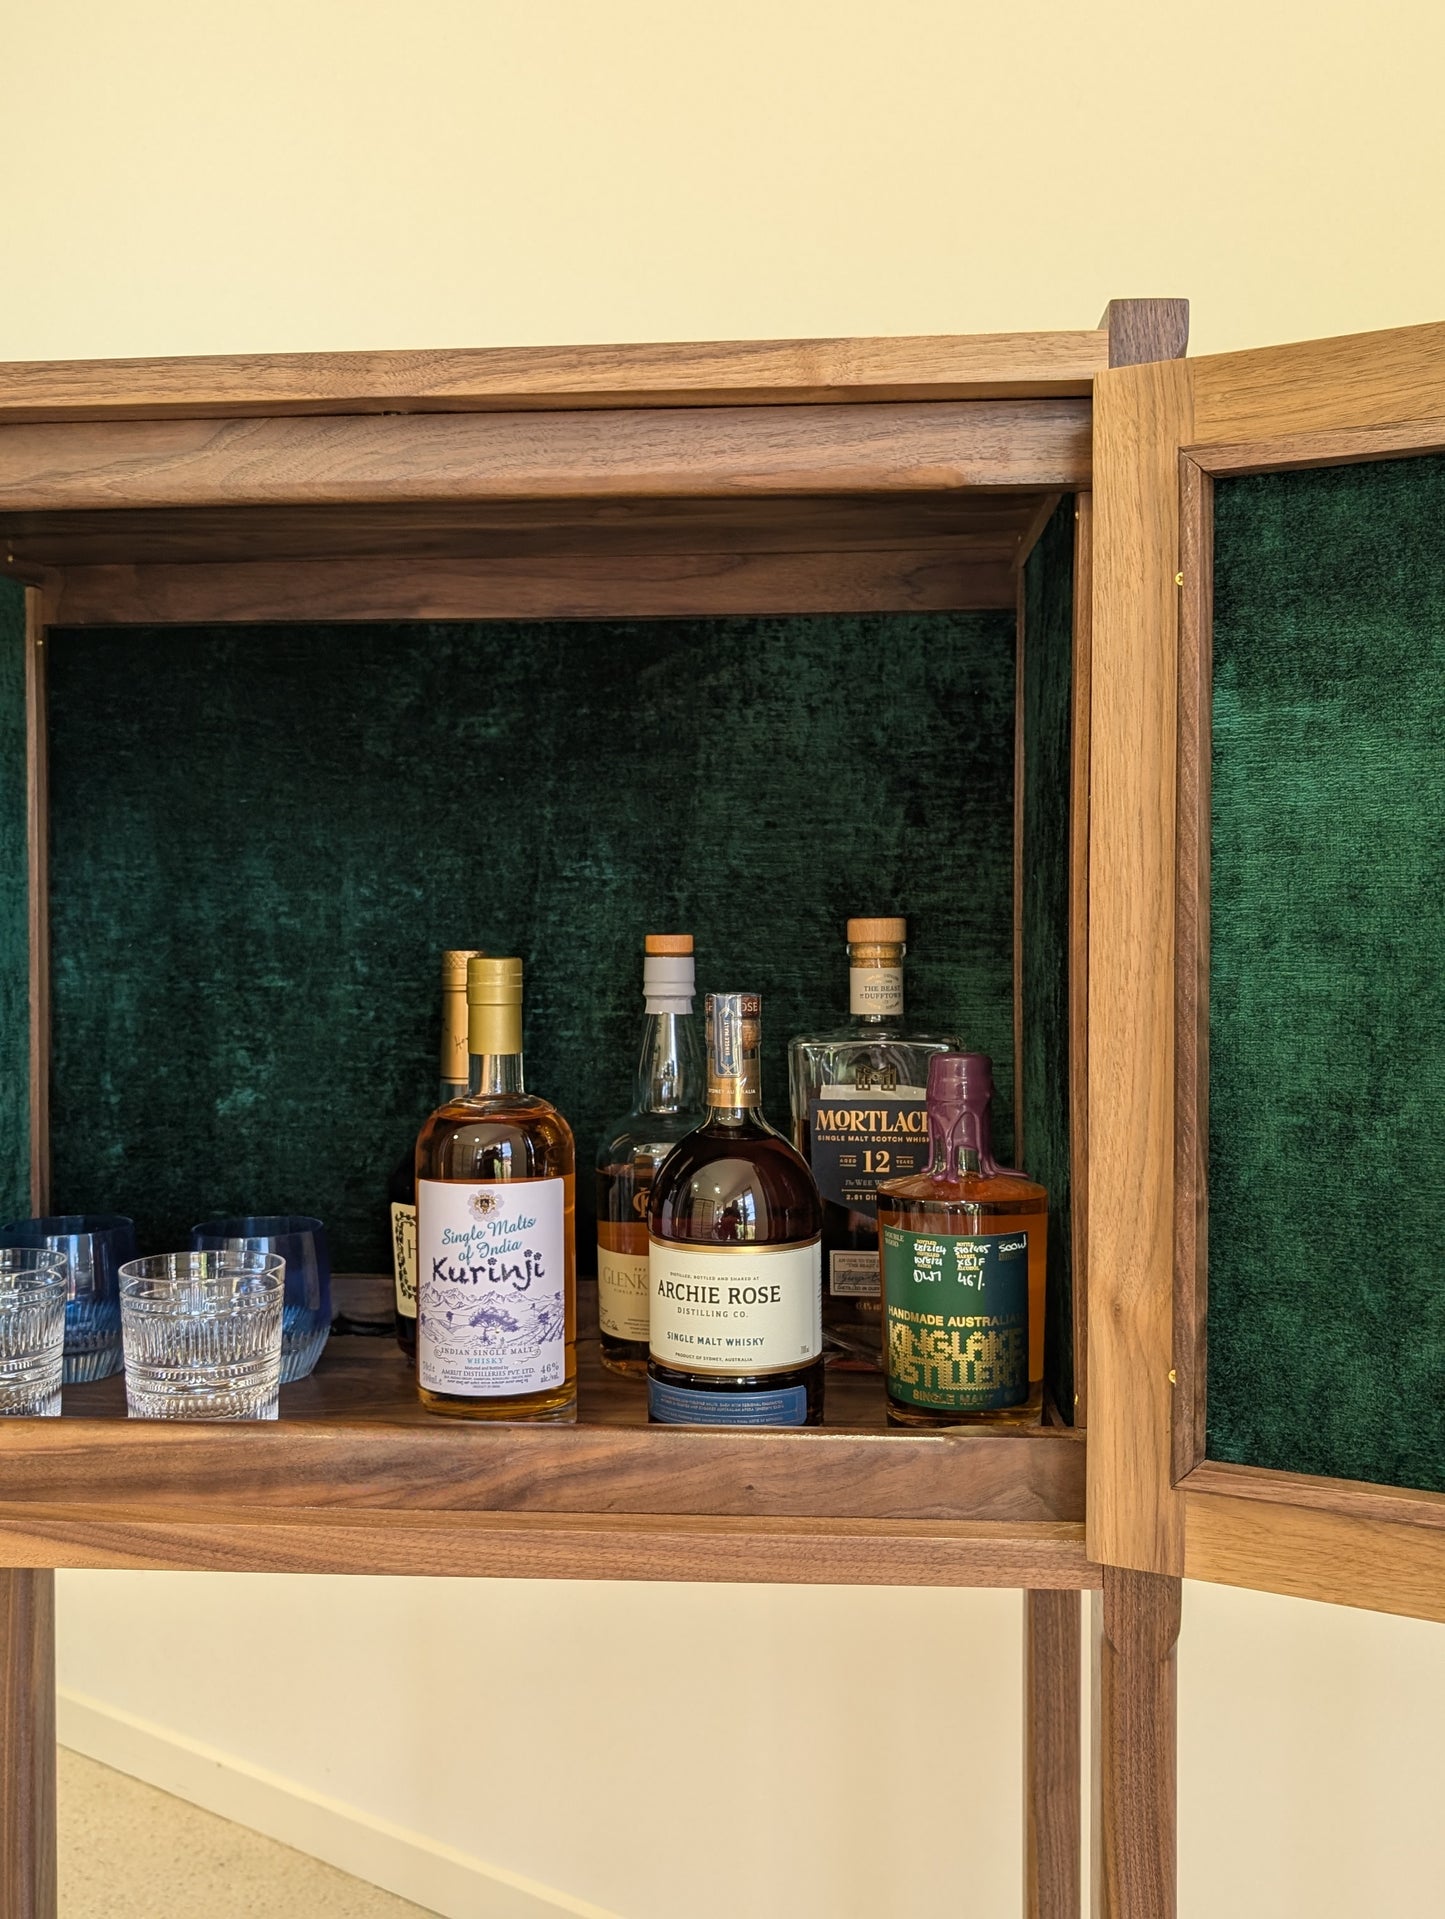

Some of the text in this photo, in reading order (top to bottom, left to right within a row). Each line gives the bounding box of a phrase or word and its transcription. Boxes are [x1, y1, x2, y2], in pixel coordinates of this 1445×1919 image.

[862, 1150, 890, 1173] 12
[442, 1214, 536, 1248] Single Malts
[458, 1238, 522, 1266] of India
[432, 1249, 546, 1292] Kurinji
[658, 1279, 781, 1305] ARCHIE ROSE
[677, 1306, 728, 1318] DISTILLING
[888, 1305, 944, 1326] HANDMADE
[667, 1331, 765, 1346] SINGLE MALT WHISKY
[888, 1320, 1021, 1361] KINGLAKE
[440, 1346, 534, 1356] INDIAN SINGLE MALT
[675, 1352, 695, 1360] PRODUCT
[540, 1362, 560, 1374] 46%
